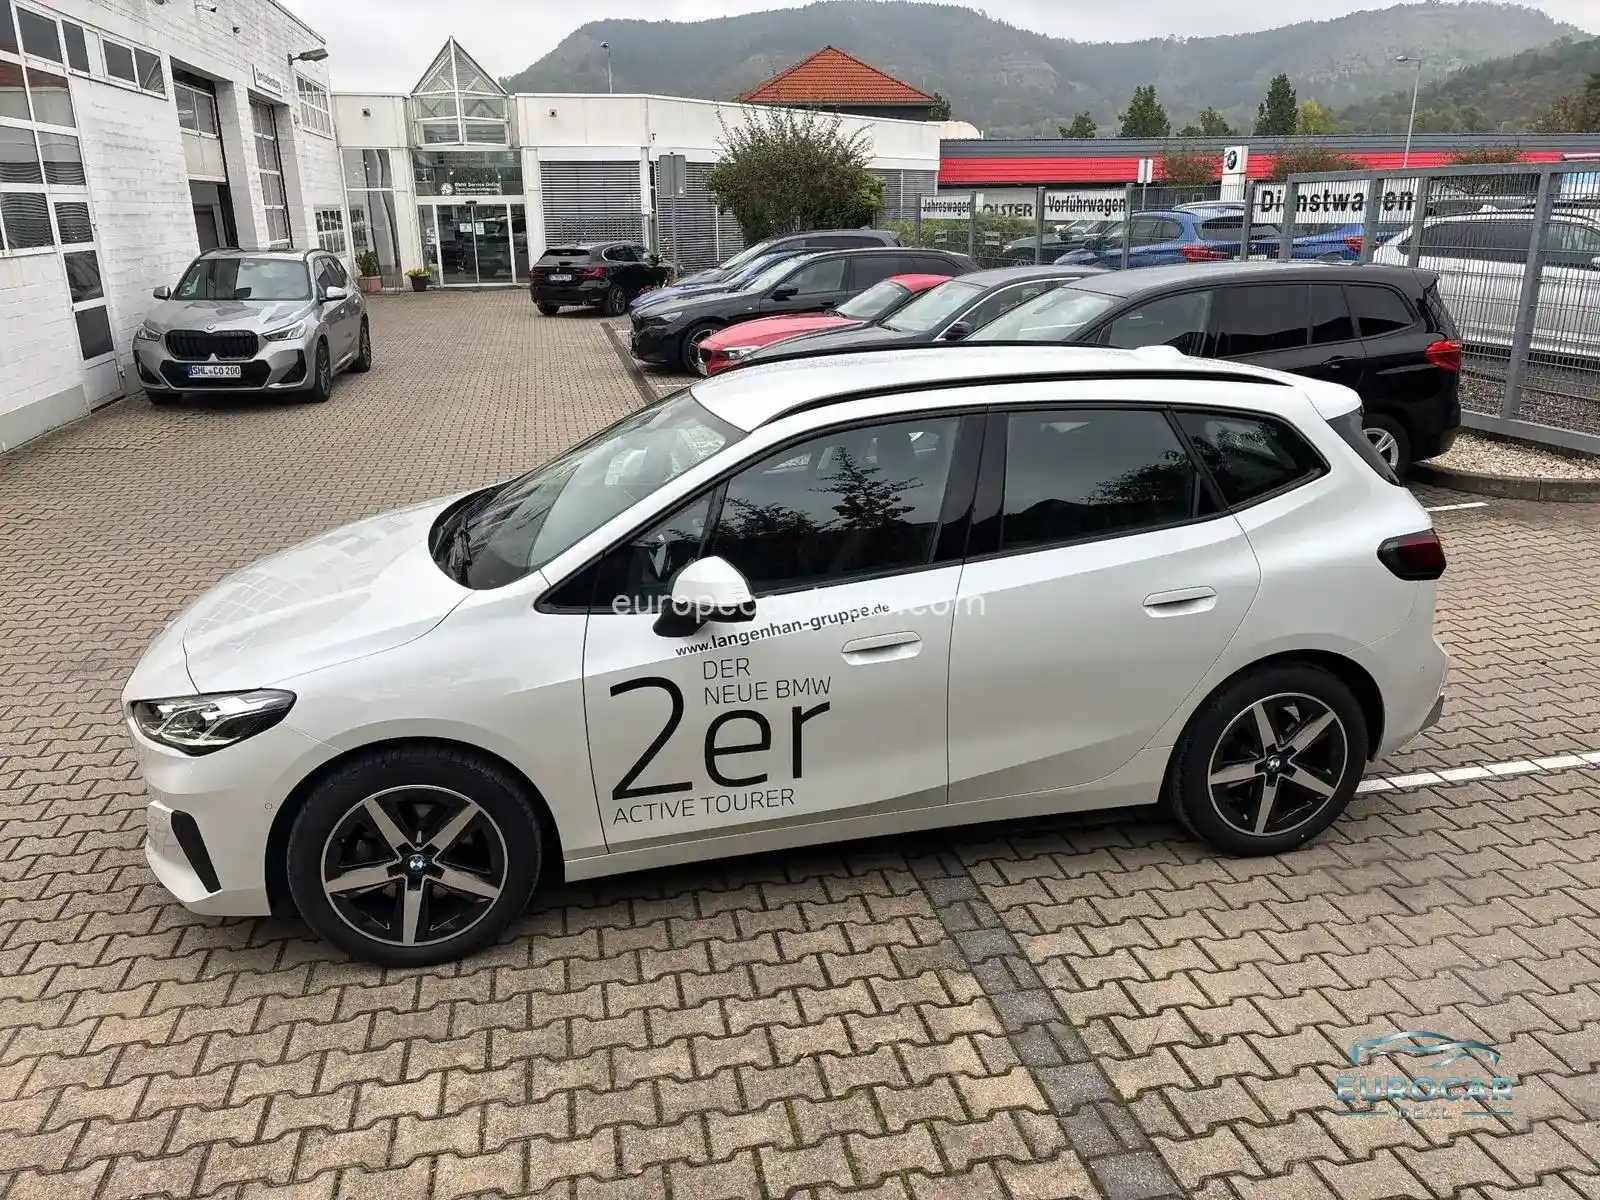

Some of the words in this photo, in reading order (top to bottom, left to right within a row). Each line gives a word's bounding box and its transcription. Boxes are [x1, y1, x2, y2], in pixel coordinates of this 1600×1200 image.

[1048, 195, 1126, 216] Vorführwagen
[1260, 189, 1413, 213] Dinstwaen
[225, 366, 240, 375] 200
[675, 603, 890, 656] www.langenhan-gruppe.de
[703, 657, 751, 680] DER
[704, 681, 768, 705] NEUE
[776, 676, 831, 699] BMW
[609, 676, 831, 800] 2er
[613, 799, 696, 825] ACTIVE
[700, 789, 795, 814] TOURER
